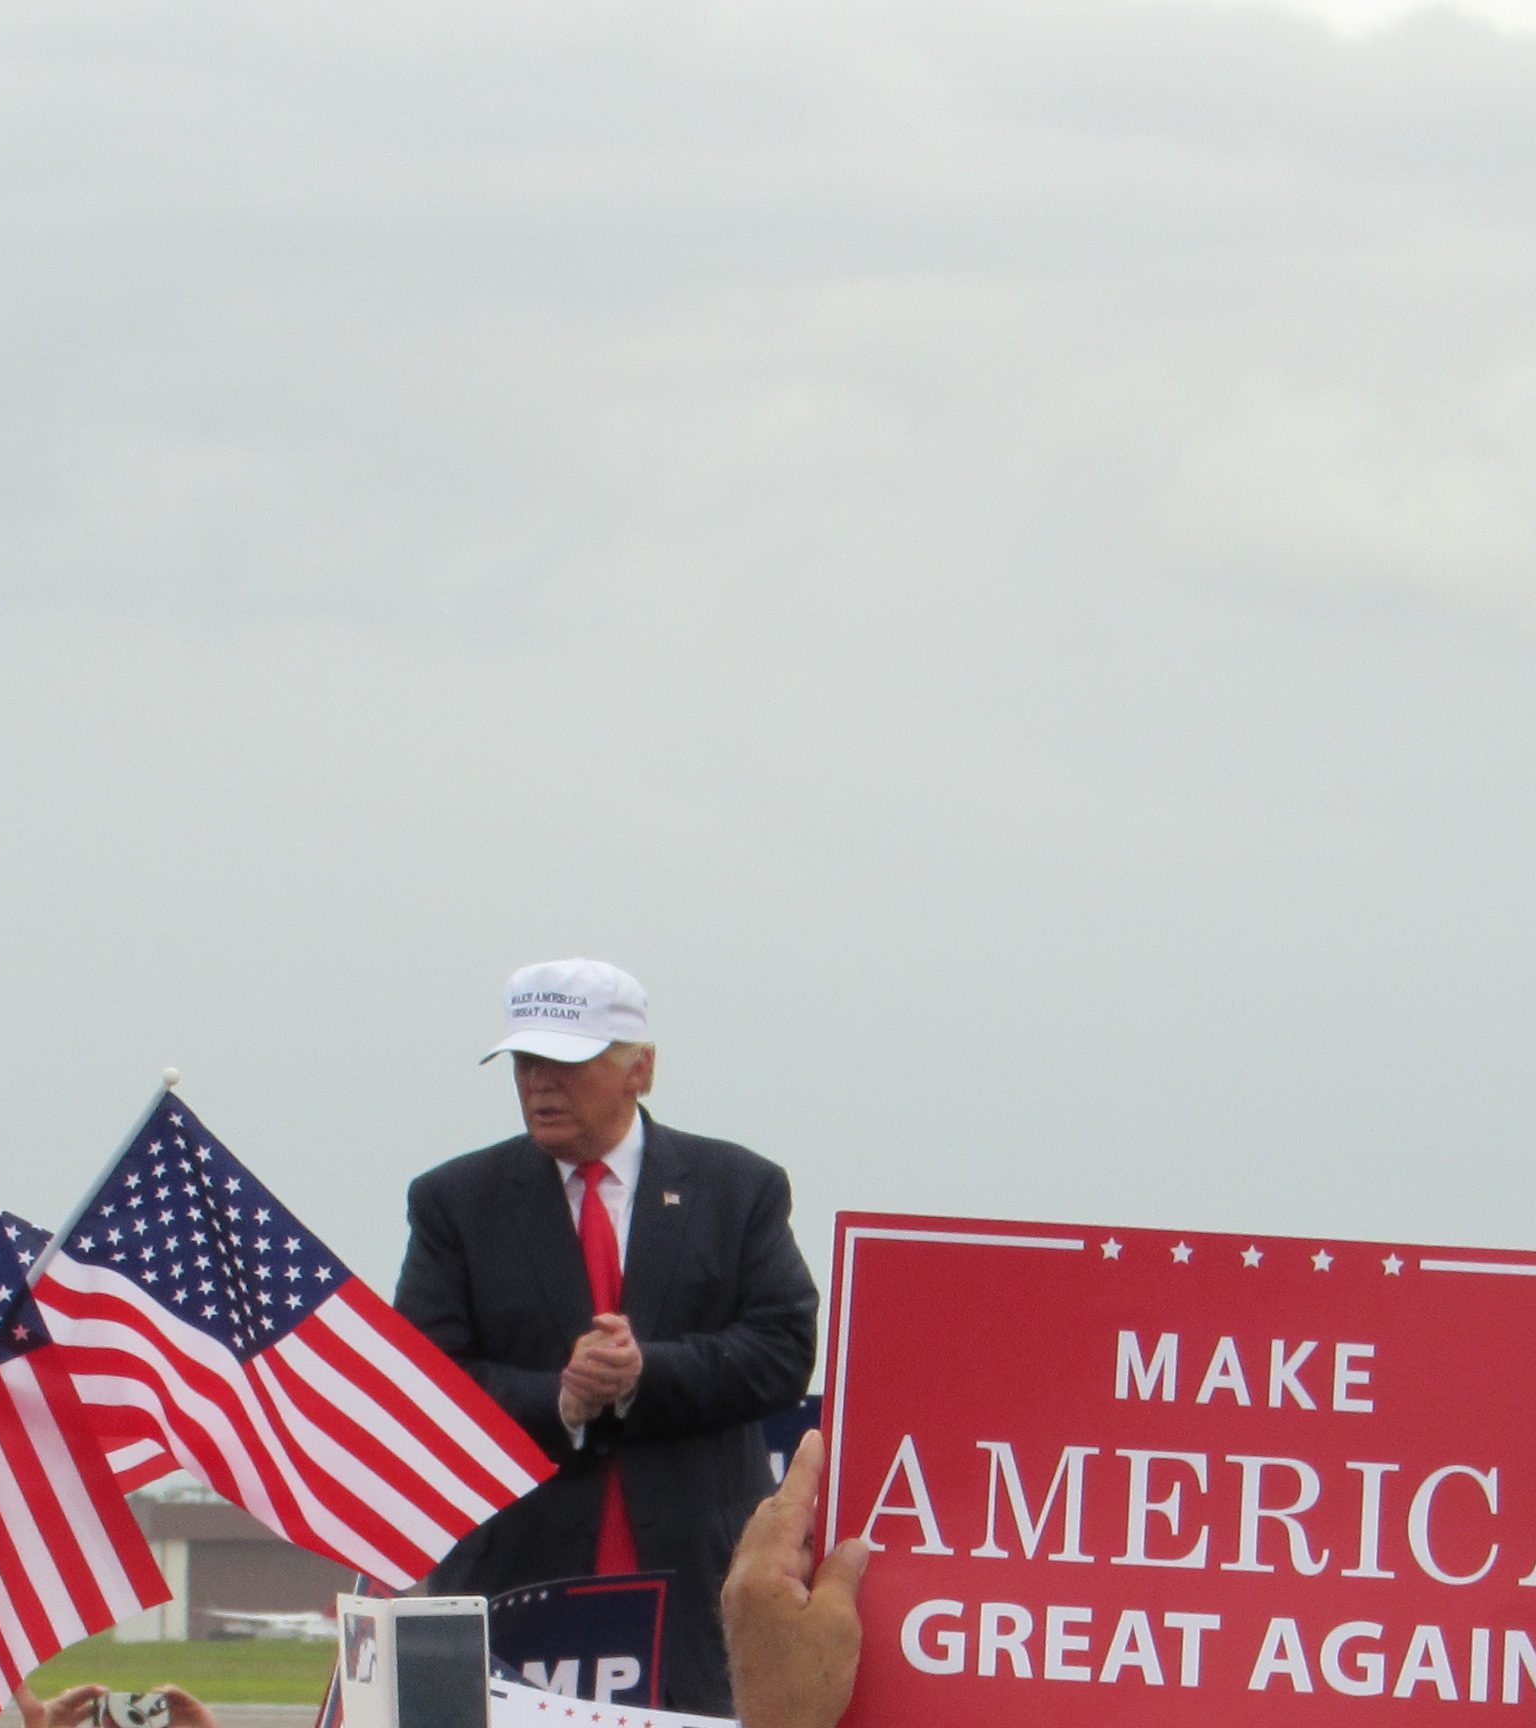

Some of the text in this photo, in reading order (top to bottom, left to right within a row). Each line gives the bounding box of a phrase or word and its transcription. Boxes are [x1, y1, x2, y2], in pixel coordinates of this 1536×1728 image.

[535, 993, 588, 1008] AMERICA
[542, 1009, 580, 1020] AGAIN
[1114, 1330, 1376, 1414] MAKE
[900, 1599, 1221, 1688] GREAT
